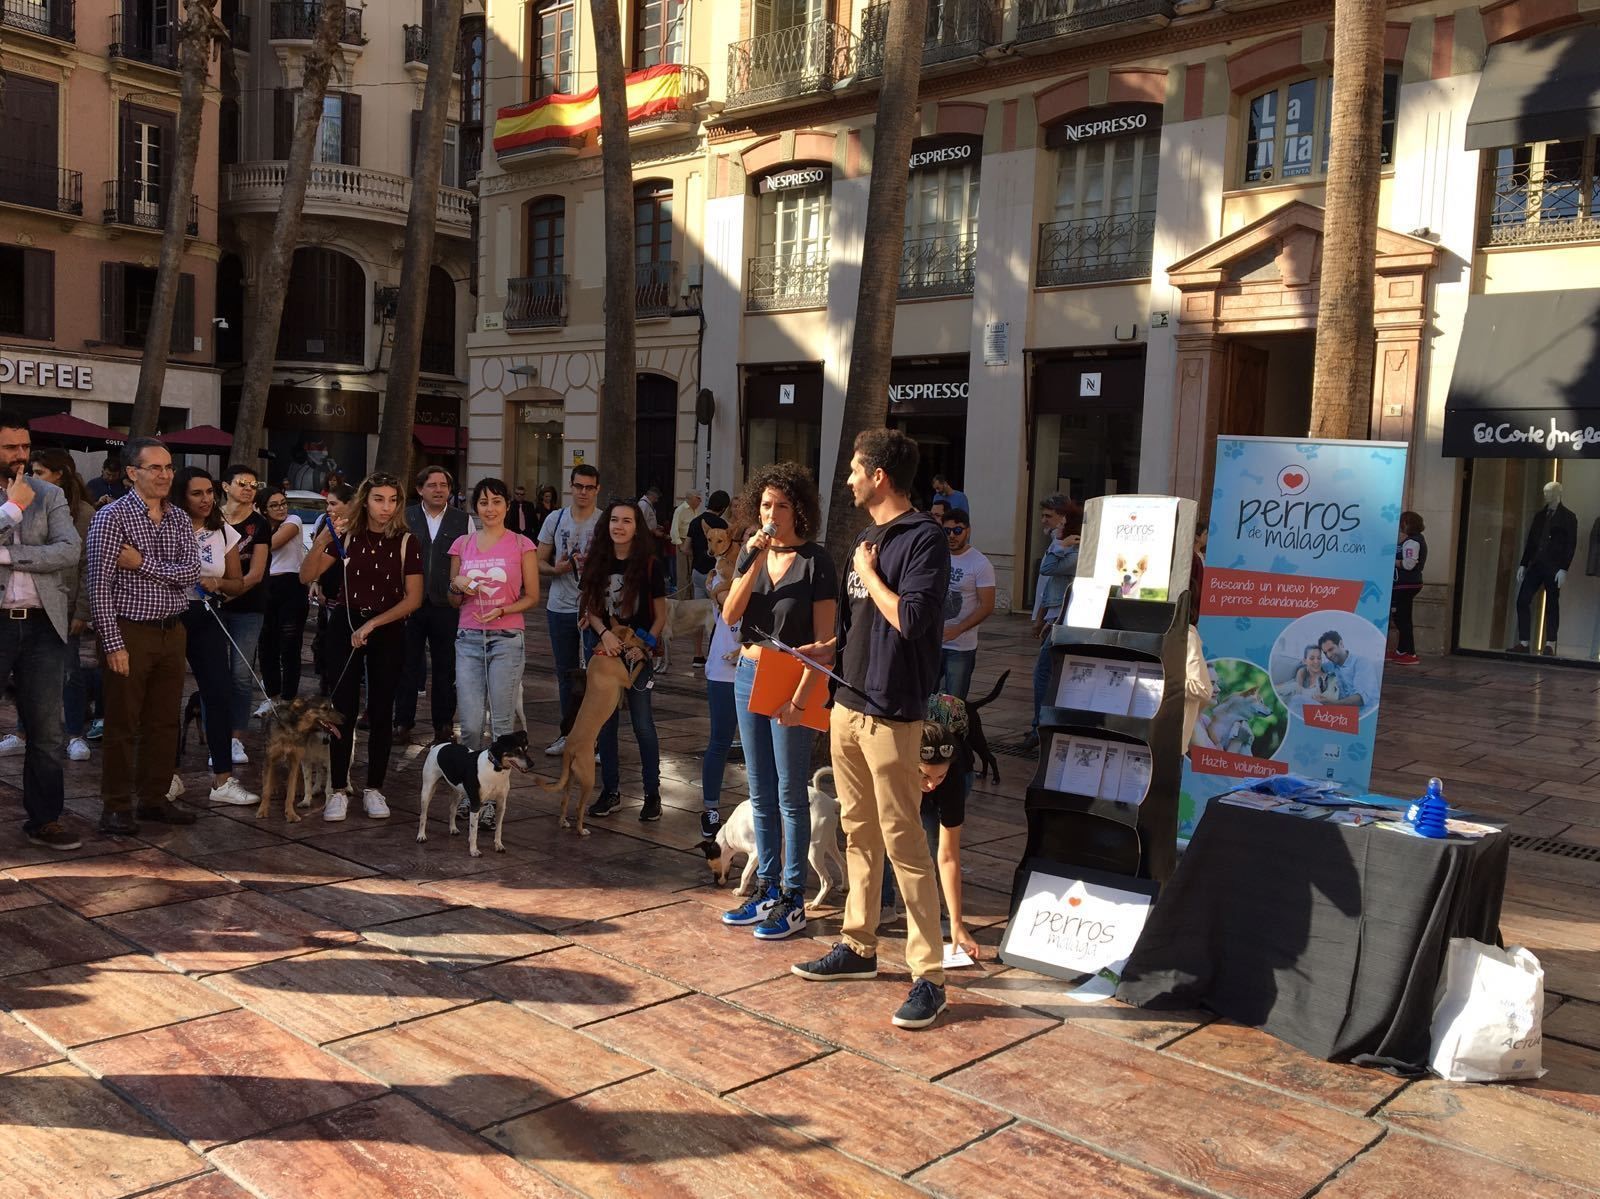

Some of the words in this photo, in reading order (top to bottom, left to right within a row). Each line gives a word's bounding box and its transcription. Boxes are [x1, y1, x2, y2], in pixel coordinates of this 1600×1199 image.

[1262, 94, 1301, 123] La
[1064, 113, 1147, 141] NESPRESSO
[765, 169, 824, 190] NESPRESSO
[0, 357, 93, 390] OFFEE
[888, 382, 969, 403] NESPRESSO
[1473, 422, 1495, 443] El
[1495, 423, 1544, 444] Corte
[1236, 499, 1361, 540] perros
[1115, 523, 1155, 538] perros
[1248, 525, 1262, 539] de
[1210, 577, 1255, 590] Buscando
[1260, 583, 1272, 592] un
[1277, 582, 1304, 594] nuevo
[1310, 582, 1340, 599] hogar
[1209, 595, 1216, 603] a
[1220, 595, 1253, 607] perros
[1258, 595, 1319, 609] abandonados
[1313, 709, 1348, 727] Adopta
[1201, 753, 1229, 769] Hazte
[1030, 909, 1115, 943] perros
